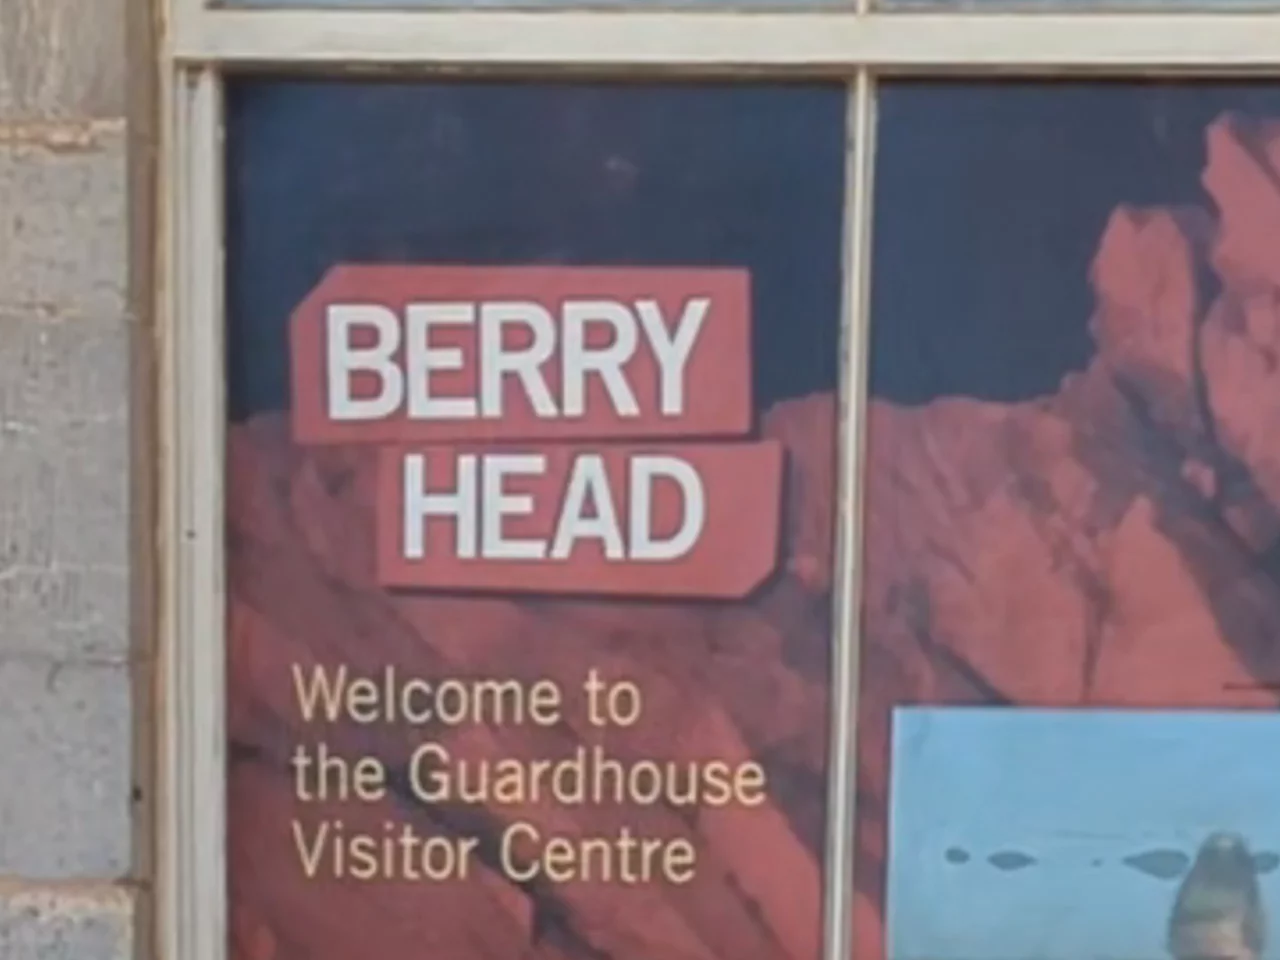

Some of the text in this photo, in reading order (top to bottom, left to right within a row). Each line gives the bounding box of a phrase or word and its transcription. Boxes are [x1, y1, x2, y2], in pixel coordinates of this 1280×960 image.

[326, 298, 711, 421] BERRY
[403, 453, 705, 561] HEAD
[292, 663, 641, 727] Welcome to
[291, 742, 768, 806] the Guardhouse
[291, 820, 697, 885] Visitor Centre
